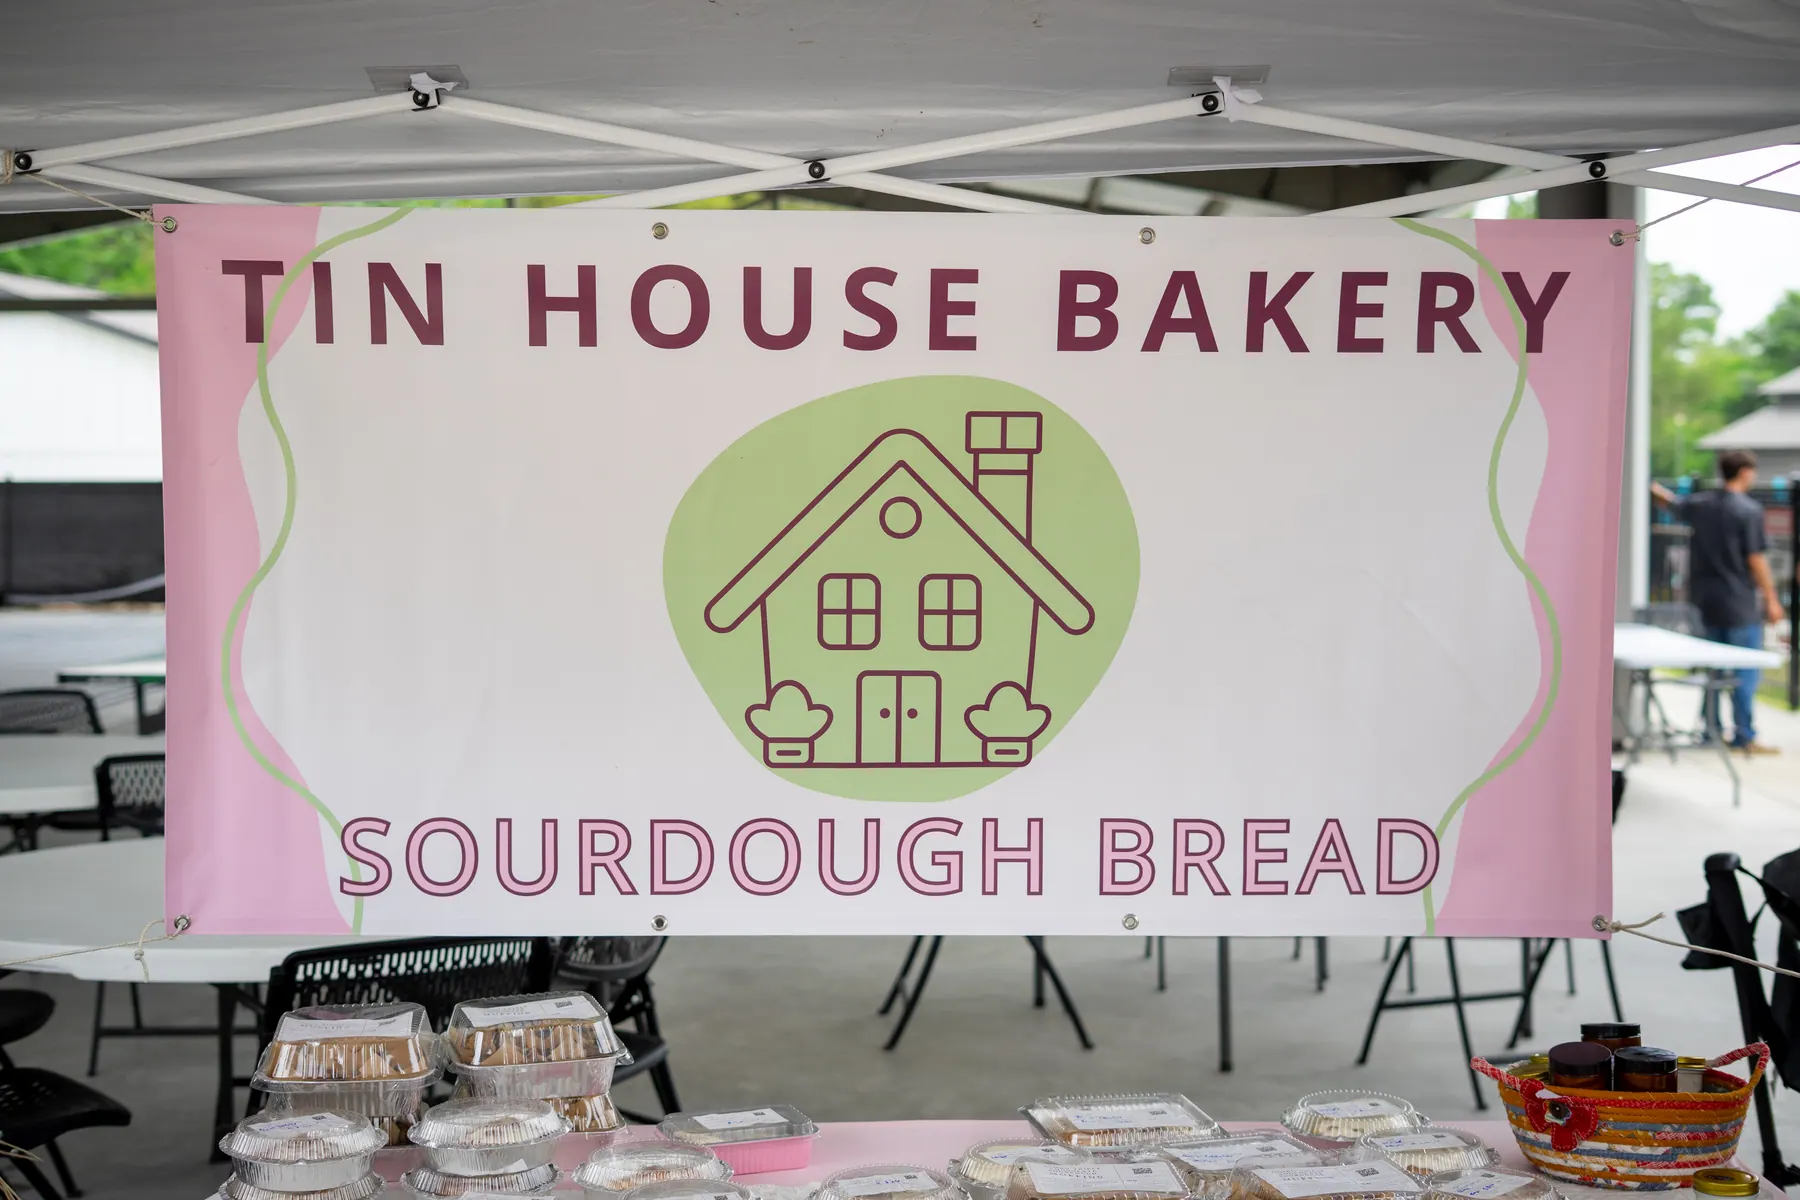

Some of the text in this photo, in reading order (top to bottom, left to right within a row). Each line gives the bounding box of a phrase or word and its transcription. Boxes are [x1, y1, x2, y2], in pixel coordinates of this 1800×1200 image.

[221, 259, 1571, 354] TIN HOUSE BAKERY
[340, 816, 1440, 897] SOURDOUGH BREAD
